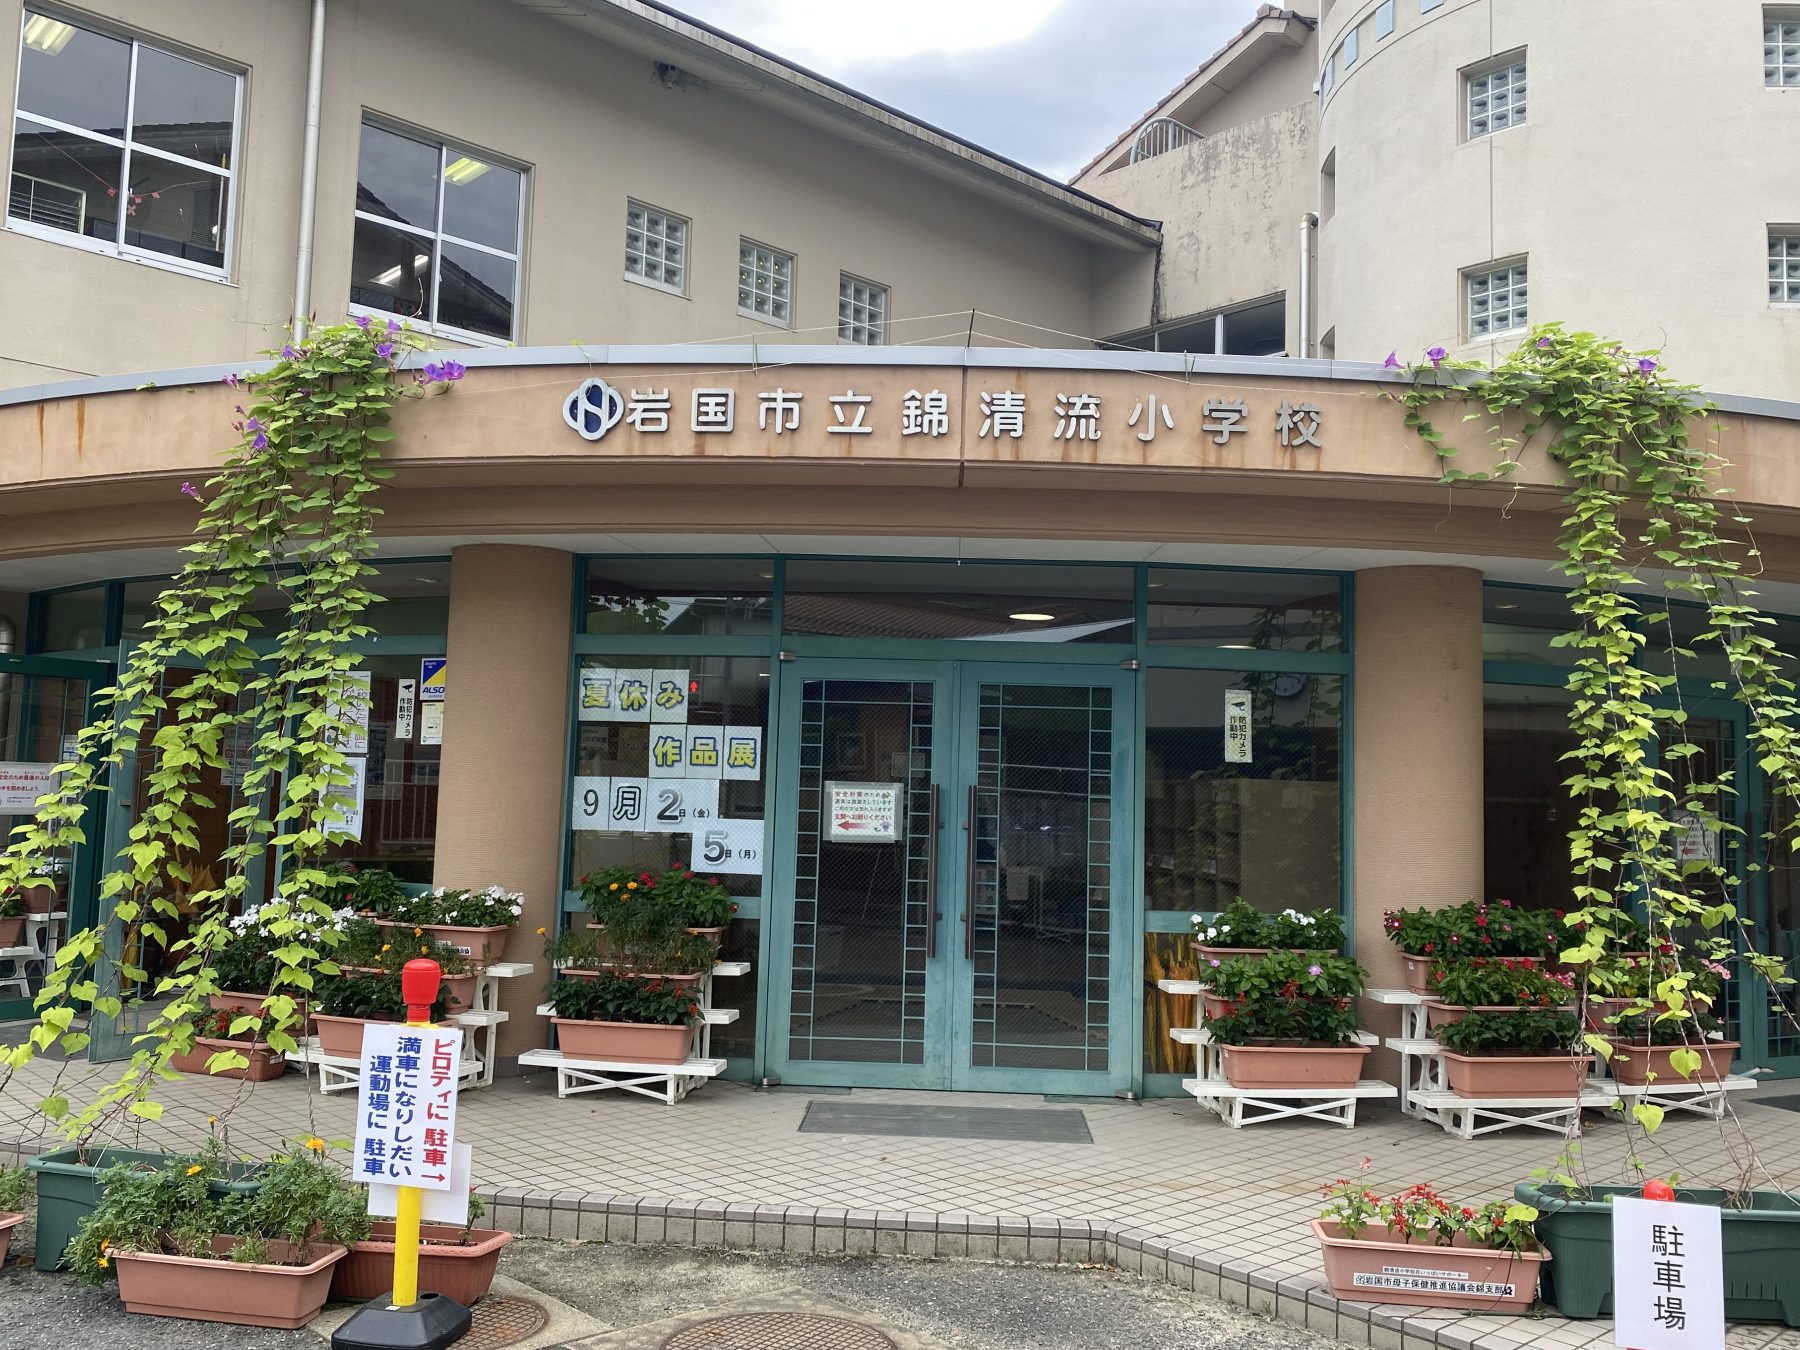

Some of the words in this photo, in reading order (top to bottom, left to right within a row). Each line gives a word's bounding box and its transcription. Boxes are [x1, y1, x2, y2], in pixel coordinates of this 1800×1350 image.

[626, 387, 1323, 447] 岩国市立錦清流小学校
[398, 697, 406, 721] 作動中
[422, 686, 446, 694] ALSO
[583, 678, 685, 711] 夏休み
[404, 697, 413, 737] 防犯カメラ
[1229, 715, 1238, 740] 作動中
[1238, 715, 1247, 758] 防犯カメラ
[653, 736, 757, 769] 作品展
[367, 1055, 392, 1130] 運動場に
[427, 1038, 455, 1121] ピロティに
[389, 1036, 422, 1178] 満車になりしだい
[362, 1138, 387, 1176] 駐車
[422, 1128, 448, 1167] 駐車
[1651, 1224, 1687, 1331] 駐車場
